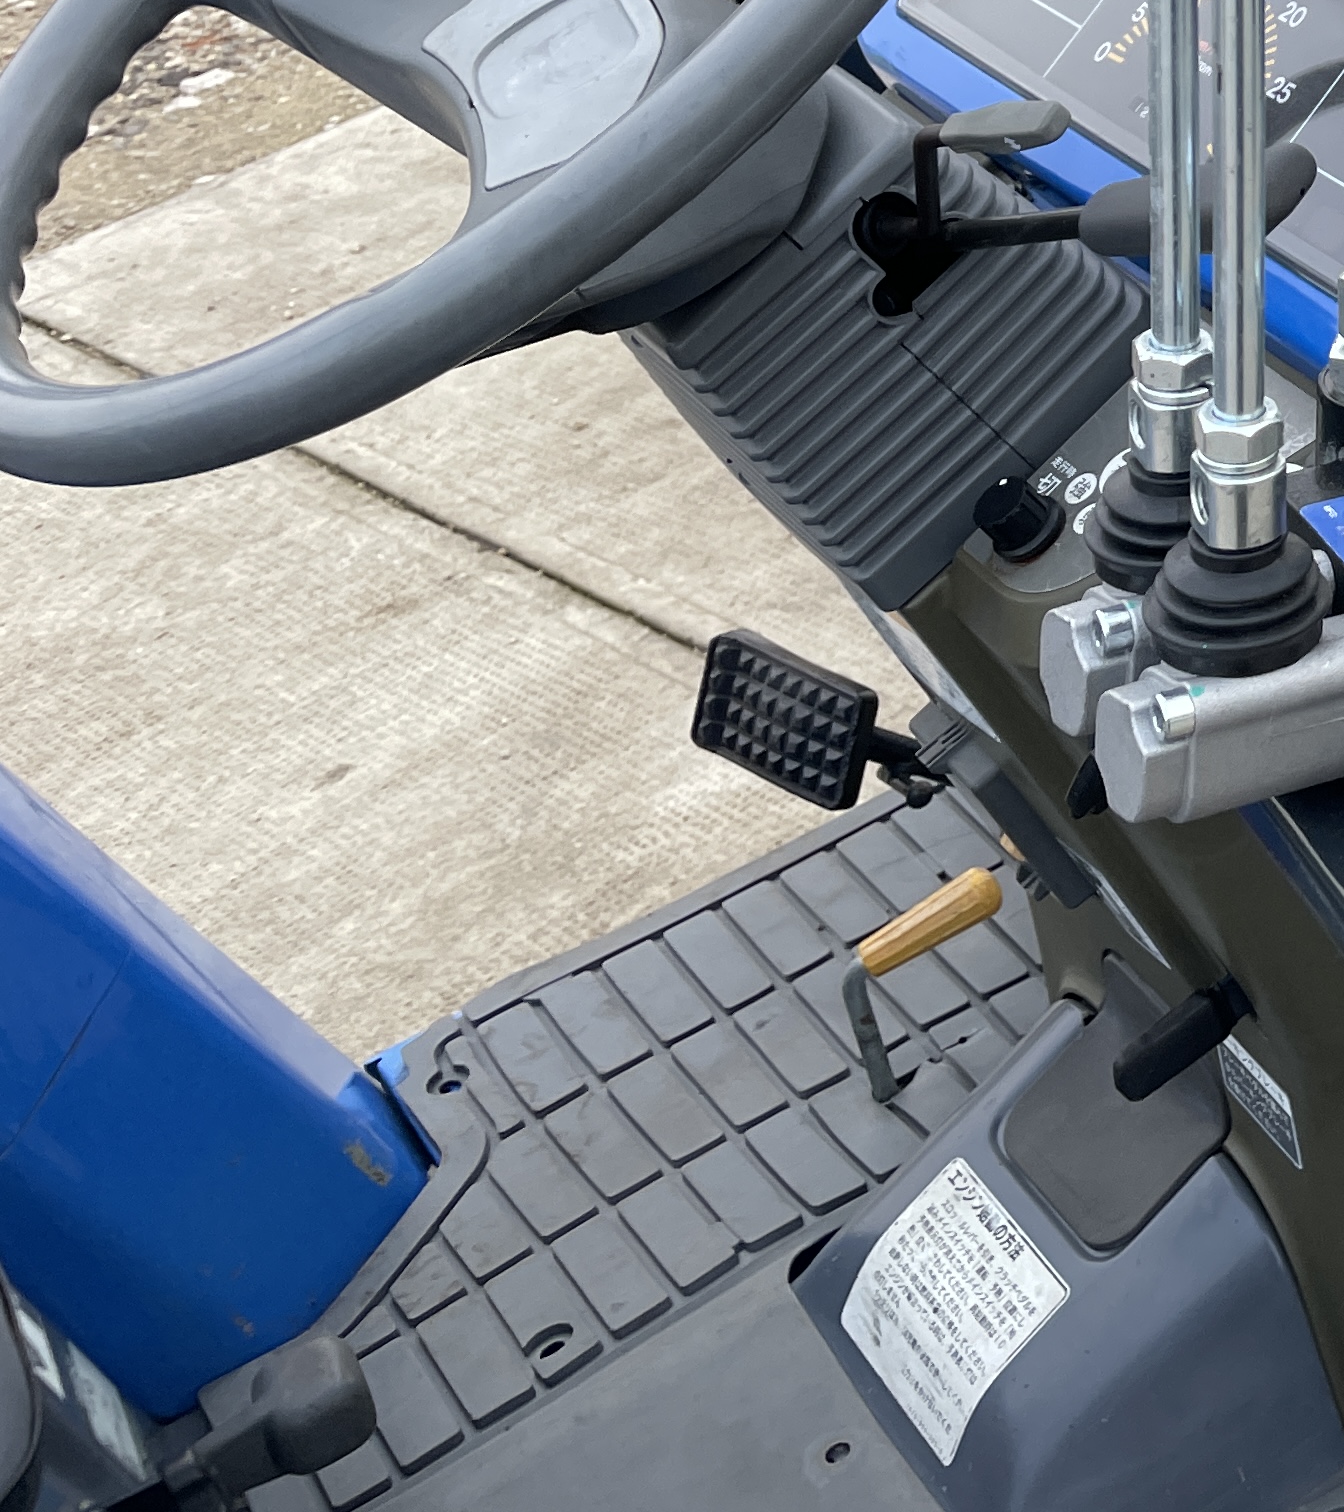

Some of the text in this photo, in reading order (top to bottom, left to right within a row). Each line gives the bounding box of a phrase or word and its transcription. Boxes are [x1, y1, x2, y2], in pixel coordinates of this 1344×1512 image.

[1131, 1, 1148, 24] 5
[1278, 1, 1308, 28] 20
[1093, 42, 1112, 62] 0
[1265, 77, 1297, 104] 25
[1036, 472, 1063, 497] 切
